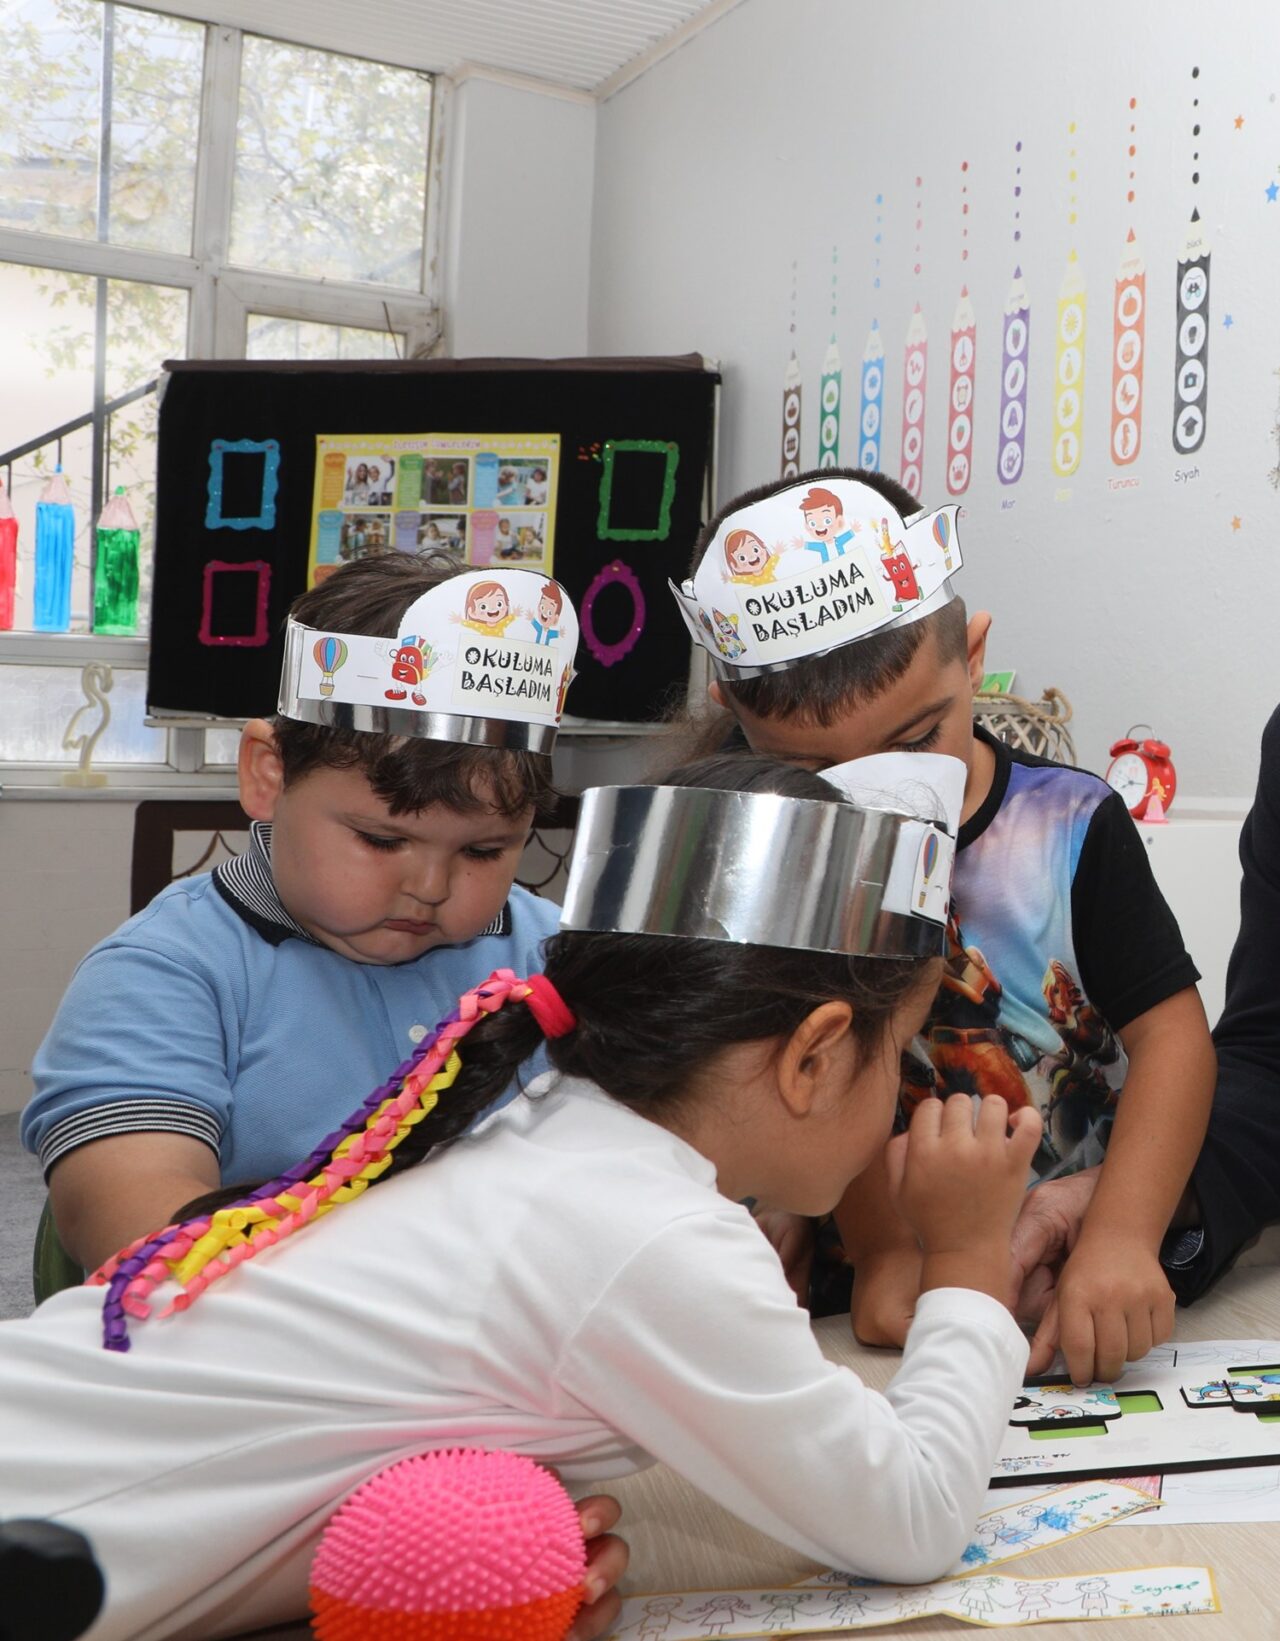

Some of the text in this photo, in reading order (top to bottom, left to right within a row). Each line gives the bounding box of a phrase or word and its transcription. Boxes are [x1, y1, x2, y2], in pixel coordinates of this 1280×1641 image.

[1107, 477, 1140, 491] Turuncu
[745, 562, 865, 617] OKULUMA
[752, 587, 875, 642] BAŞLADIM
[465, 647, 552, 677] OKULUMA
[461, 670, 551, 702] BAŞLADIM
